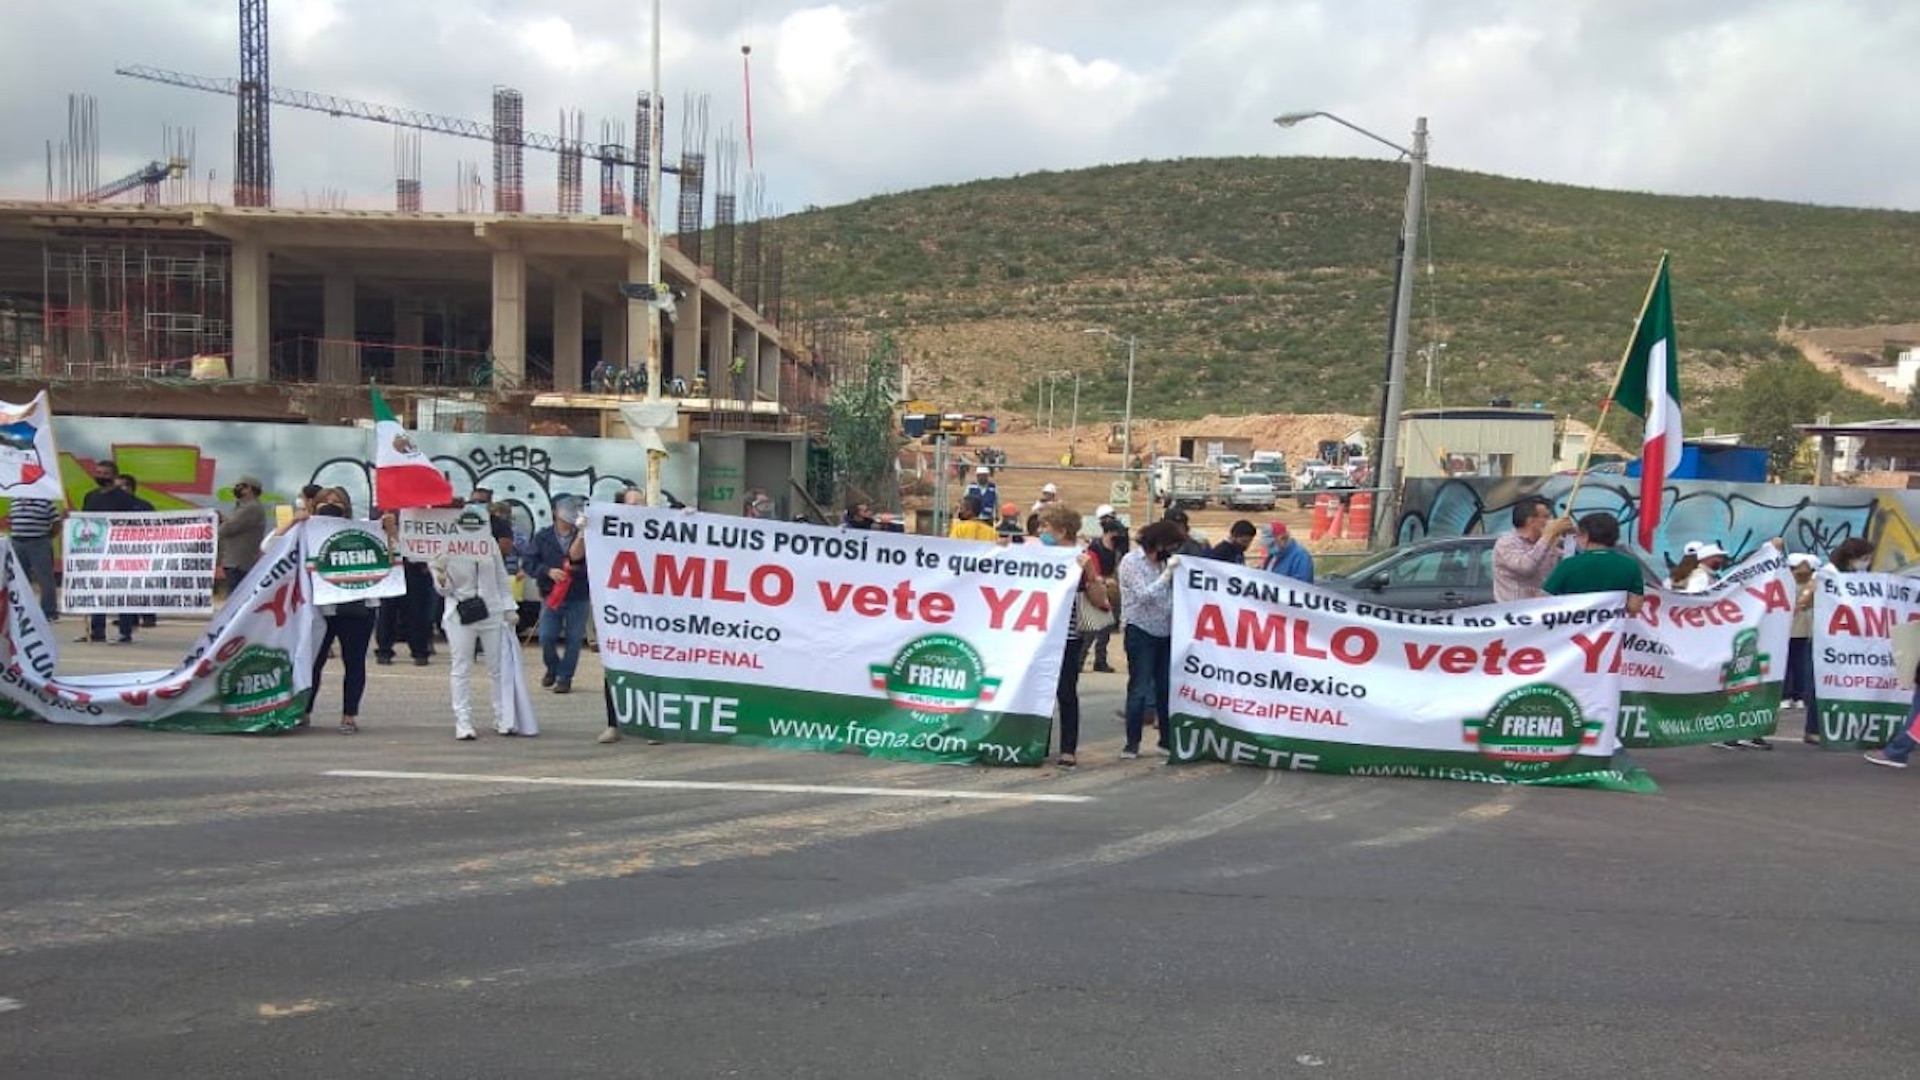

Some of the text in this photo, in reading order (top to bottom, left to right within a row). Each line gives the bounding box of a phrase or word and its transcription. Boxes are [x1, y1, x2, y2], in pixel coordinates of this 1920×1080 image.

[403, 520, 459, 535] FRENA
[447, 540, 489, 555] AMLO
[602, 515, 1068, 580] En SAN LUIS POTOSÍ no te queremos
[329, 549, 379, 567] FRENA
[606, 550, 1050, 632] AMLO vete YA
[1189, 568, 1218, 592] En
[1226, 576, 1279, 604] SAN
[1463, 616, 1496, 628] no
[1669, 597, 1744, 628] vete
[1745, 577, 1792, 614] YA
[1845, 581, 1883, 598] SAN
[604, 605, 782, 643] SomosMexico
[1194, 603, 1379, 666] AMLO
[1403, 638, 1547, 676] vete
[606, 638, 765, 670] #LOPEZalPENAL
[908, 664, 967, 690] FRENA
[1183, 654, 1367, 699] SomosMexico
[610, 675, 740, 735] ÚNETE
[1178, 683, 1350, 727] #LOPEZalPENAL
[1501, 715, 1564, 737] FRENA
[768, 716, 1022, 763] www.frena.commx
[1173, 720, 1321, 771] ÚNETE
